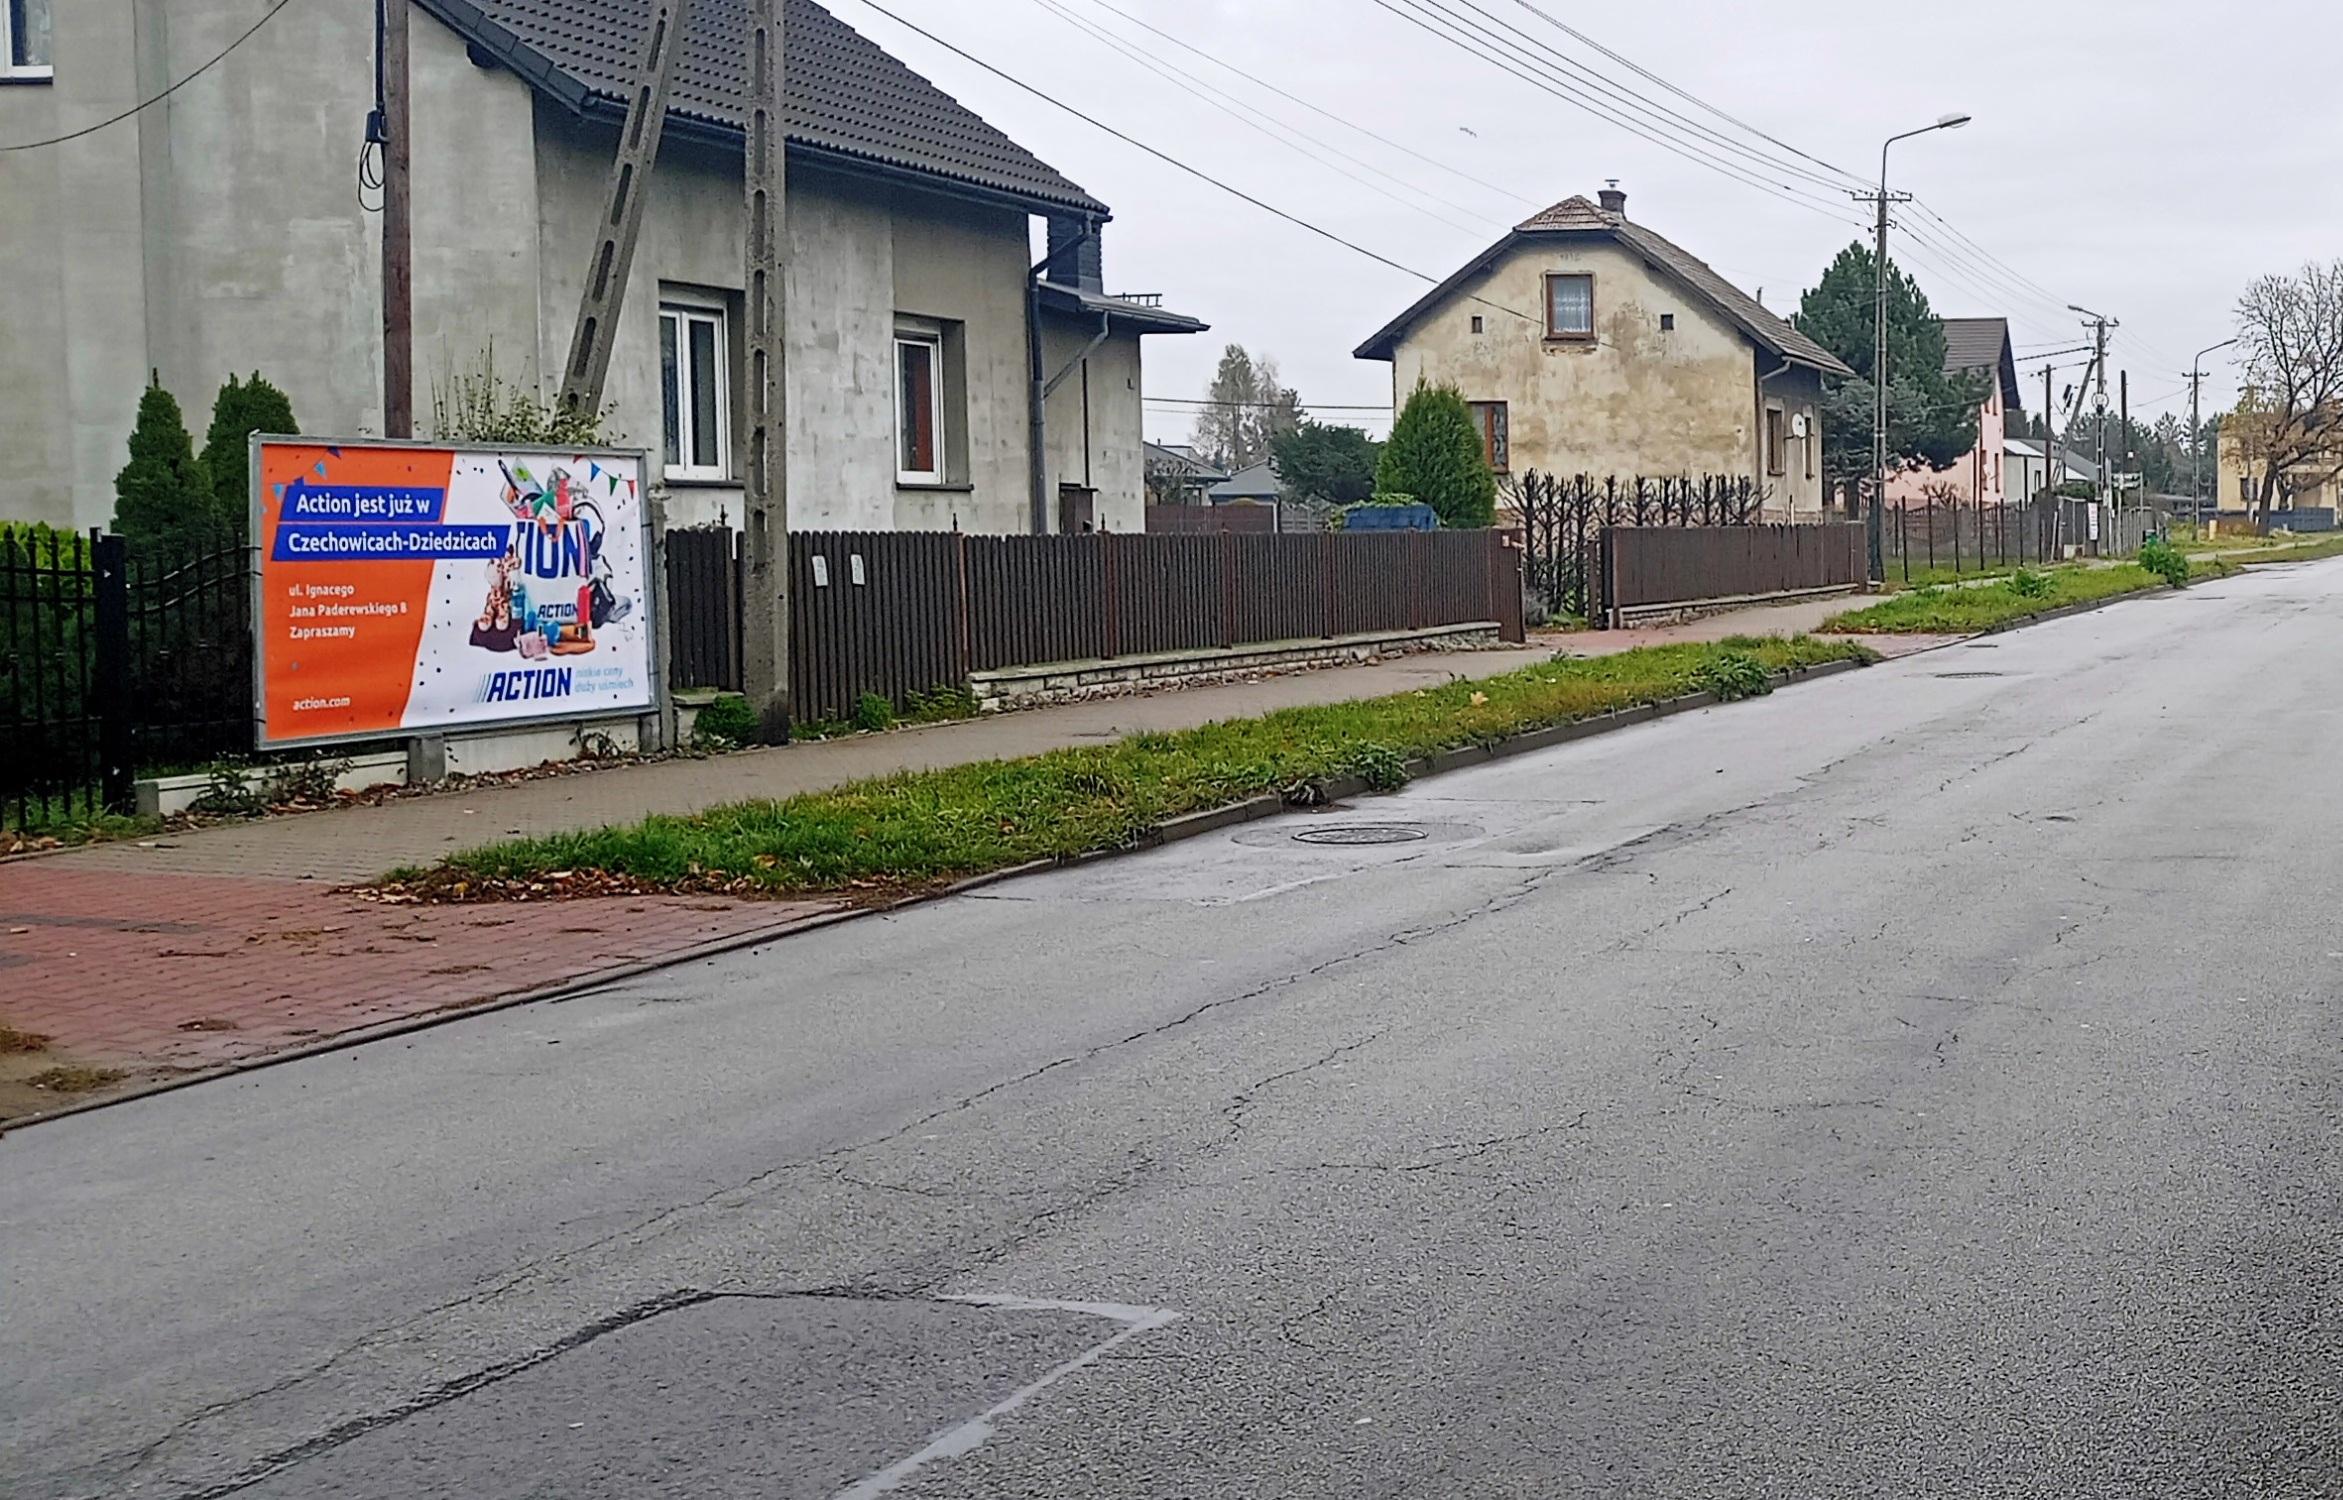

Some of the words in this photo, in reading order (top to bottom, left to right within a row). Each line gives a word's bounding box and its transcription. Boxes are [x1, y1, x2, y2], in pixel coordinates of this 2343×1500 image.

[296, 493, 351, 514] Action
[354, 493, 386, 518] jest
[388, 493, 413, 518] już
[416, 499, 430, 514] w
[288, 531, 497, 553] Czechowicach-Dziedzicach
[289, 584, 303, 596] ul.
[306, 584, 355, 598] Ignacego
[289, 605, 316, 618] Jana
[318, 602, 398, 617] Paderewskiego
[537, 603, 579, 618] ACTION
[289, 626, 356, 640] Zapraszamy
[486, 667, 572, 703] ACTION
[293, 696, 351, 711] action.com
